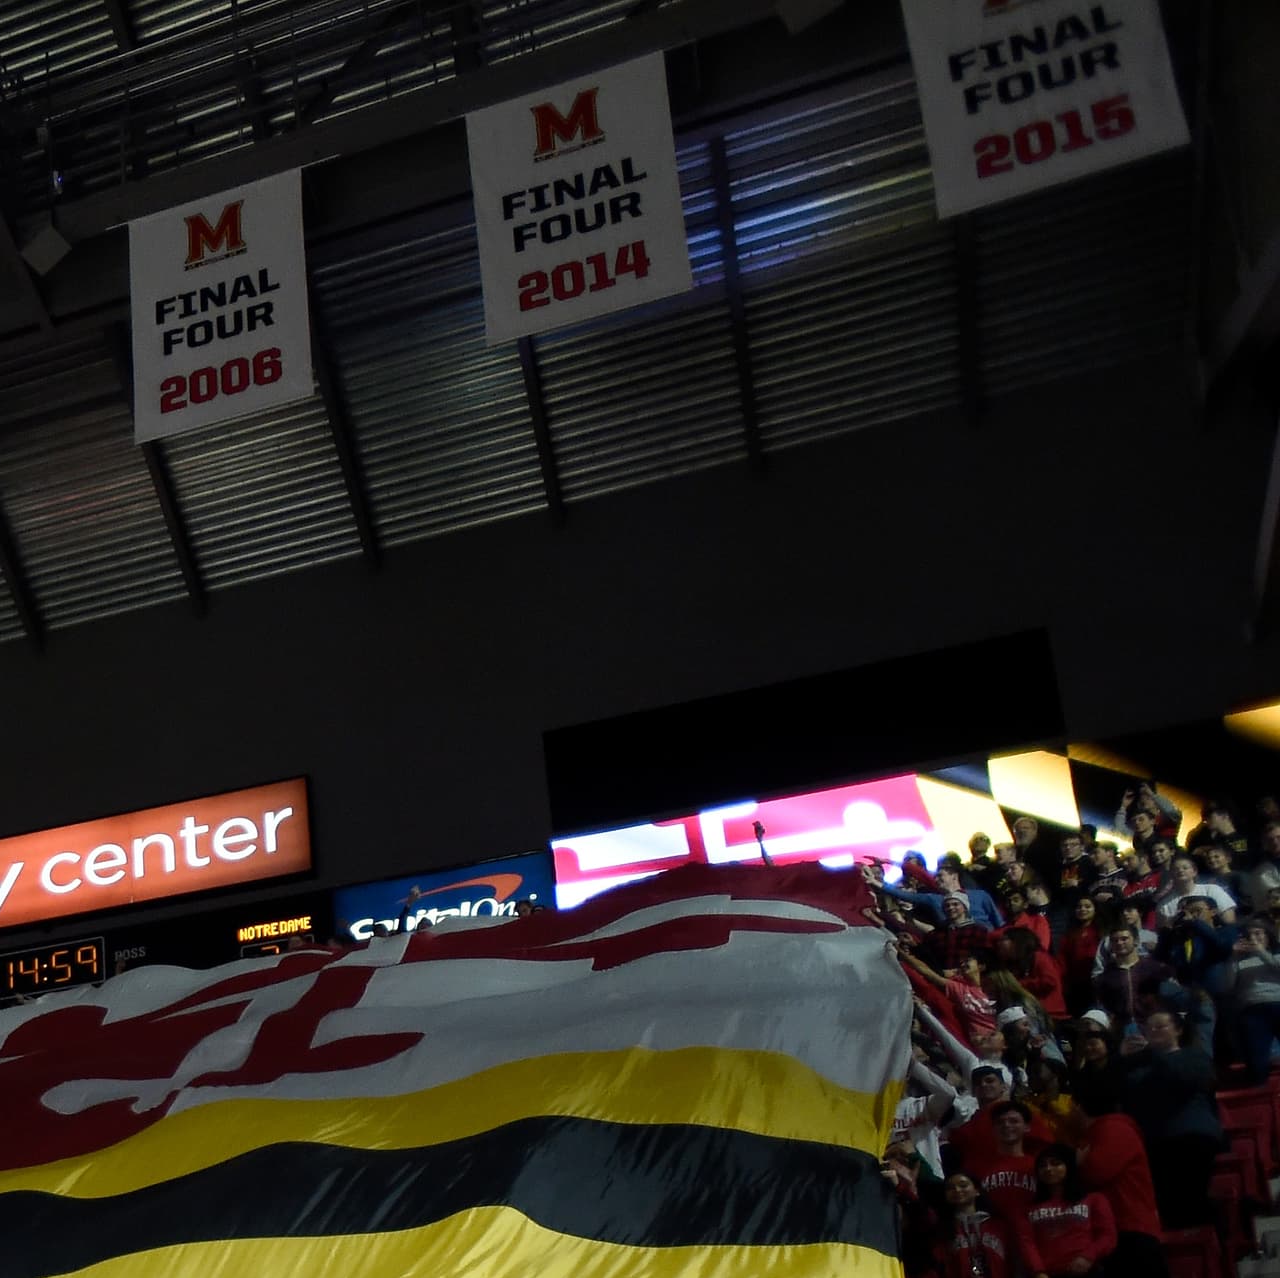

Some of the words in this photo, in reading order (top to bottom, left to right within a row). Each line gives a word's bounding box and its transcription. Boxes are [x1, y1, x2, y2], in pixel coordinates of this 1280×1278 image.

[948, 5, 1123, 82] FINAL
[965, 41, 1121, 115] FOUR
[974, 94, 1135, 179] 2015
[503, 157, 647, 220] FINAL
[514, 192, 643, 252] FOUR
[156, 268, 280, 325] FINAL
[518, 240, 650, 312] 2014
[163, 302, 274, 356] FOUR
[160, 347, 283, 414] 2006
[40, 807, 294, 895] center
[239, 922, 279, 942] NOTRE
[279, 916, 312, 934] DAME
[6, 944, 100, 991] 14:59
[981, 1170, 1037, 1193] MARYLAN
